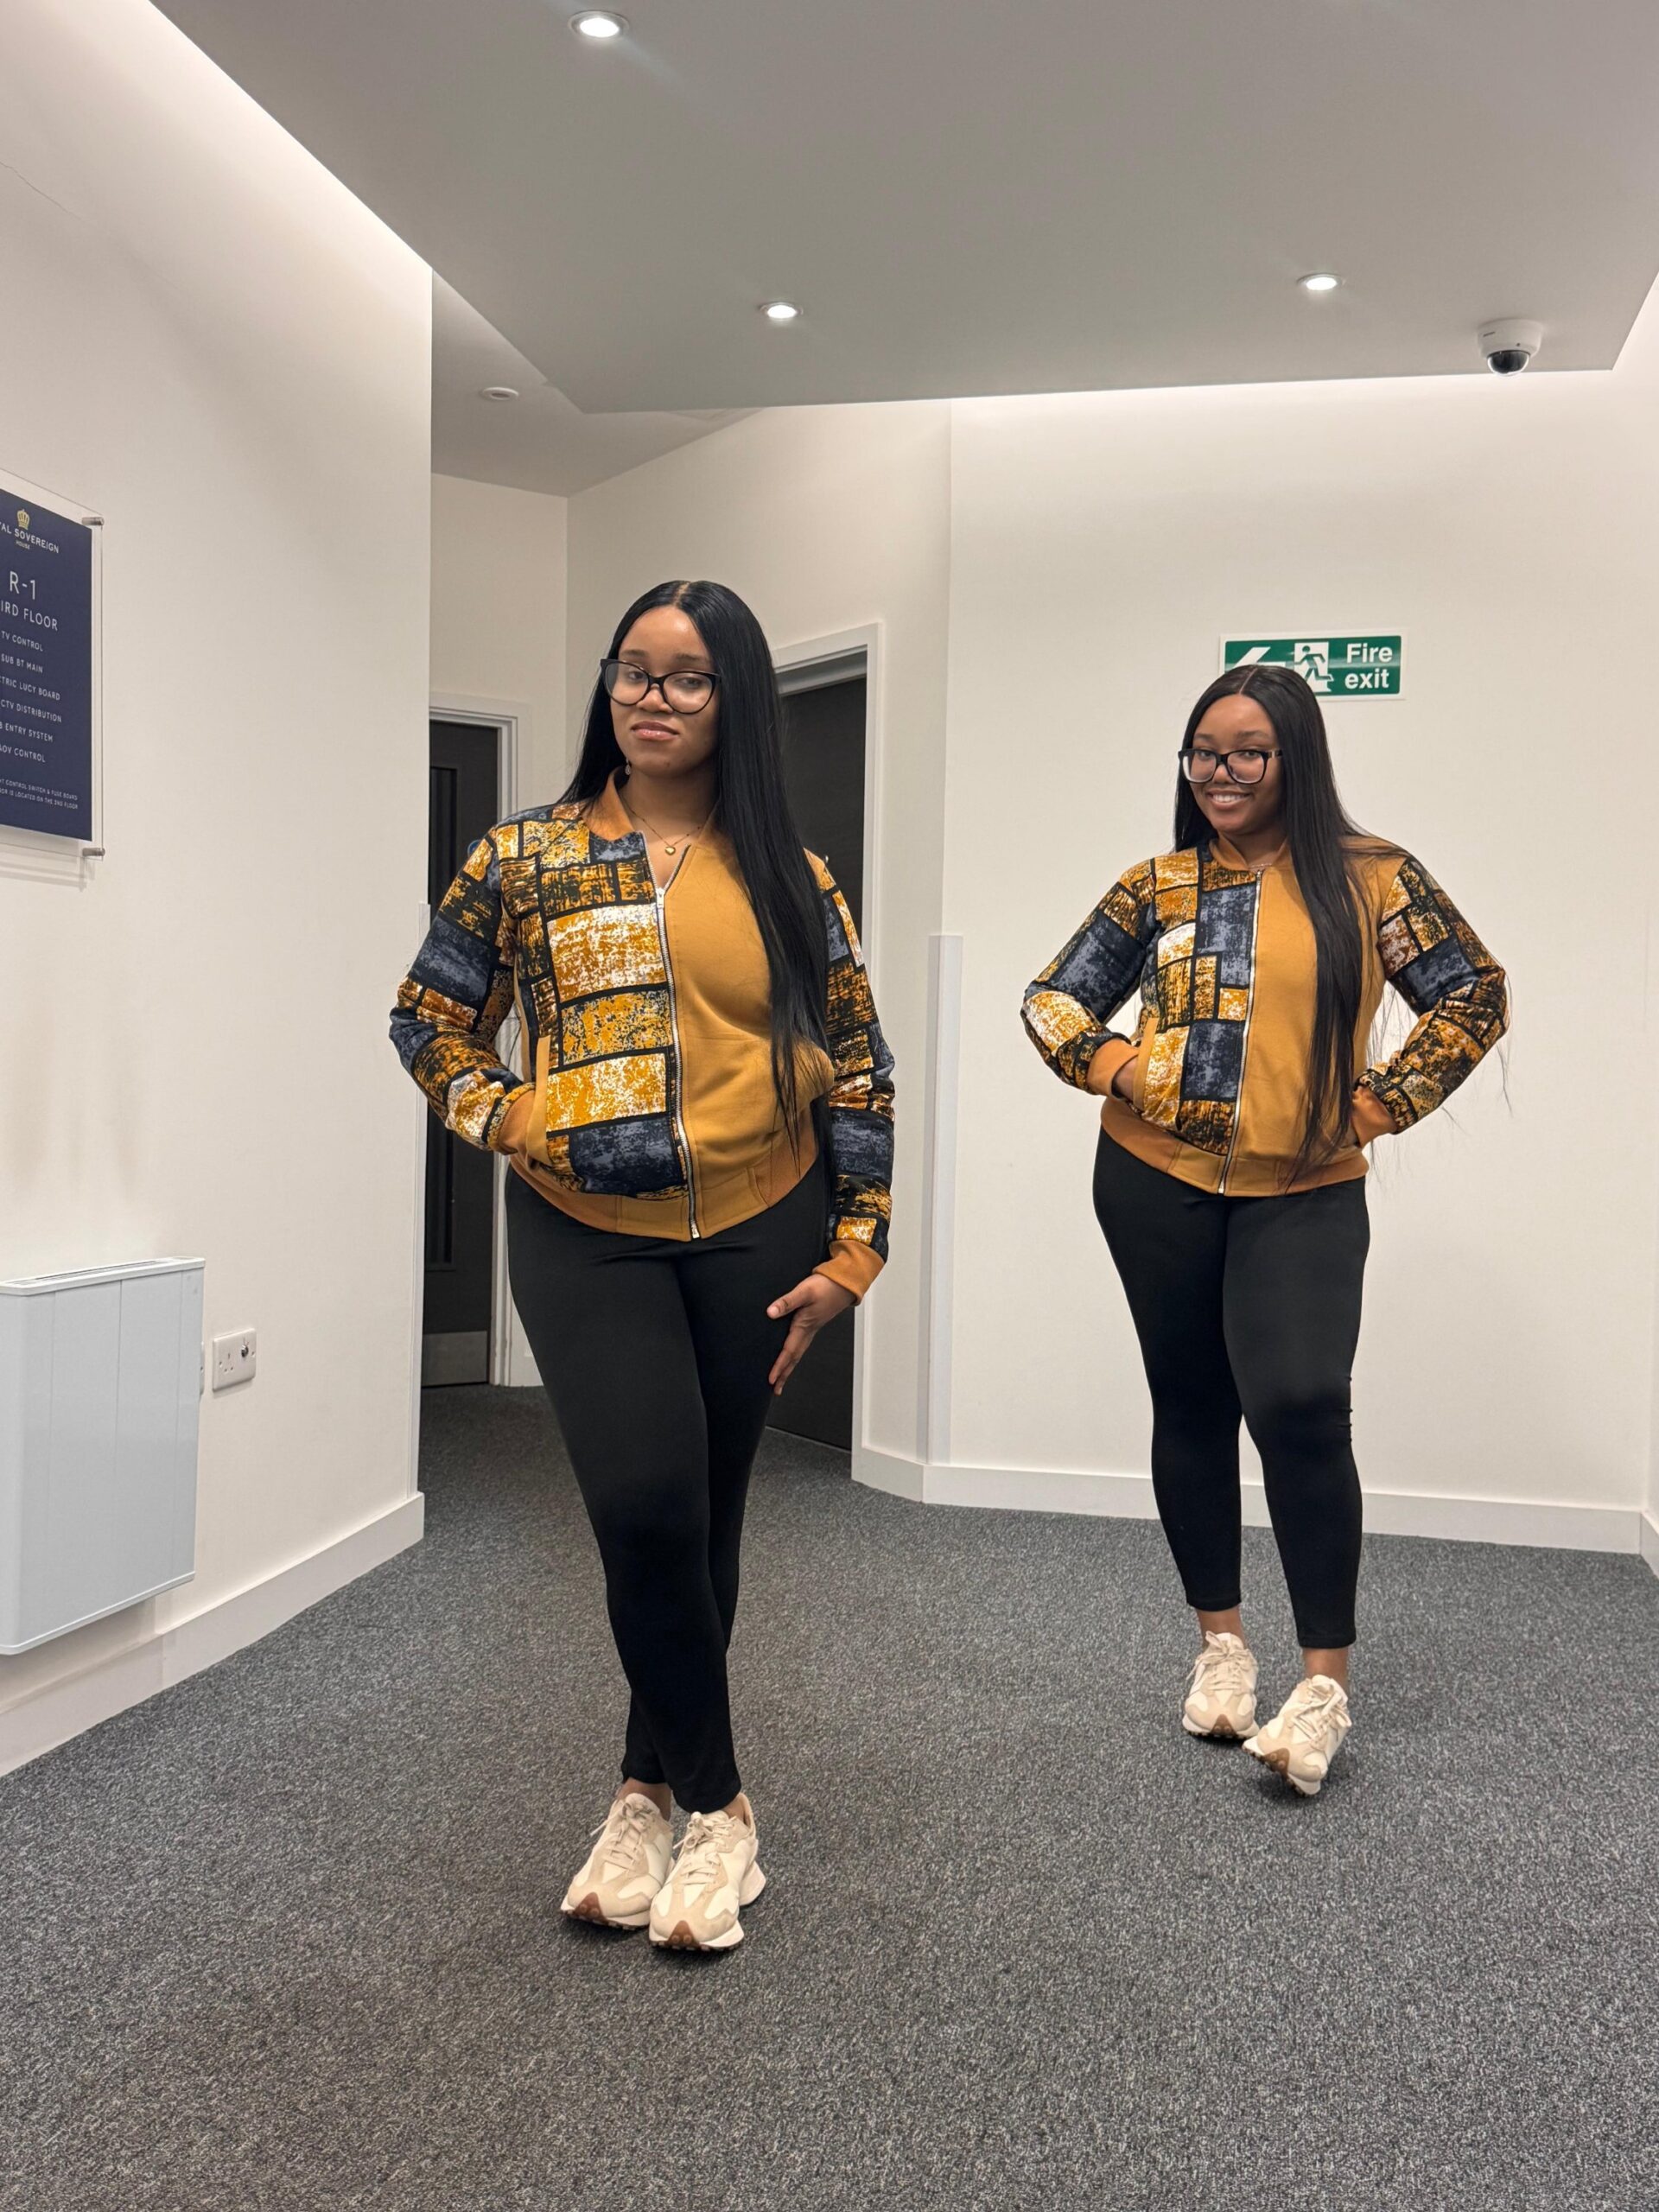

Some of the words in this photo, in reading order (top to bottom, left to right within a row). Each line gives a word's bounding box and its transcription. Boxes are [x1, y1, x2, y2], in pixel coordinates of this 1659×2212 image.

[0, 522, 12, 534] AL
[15, 528, 59, 553] SOVEREIGN
[10, 570, 35, 600] R-1
[24, 608, 58, 631] FLOOR
[12, 635, 43, 652] CONTROL
[1346, 643, 1393, 664] Fire
[1, 653, 14, 664] SUB
[16, 658, 24, 668] BT
[27, 662, 43, 673] MAIN
[0, 676, 17, 688] TRIC
[20, 682, 36, 694] LUCY
[38, 688, 60, 701] BOARD
[1344, 668, 1389, 689] exit
[16, 703, 62, 723] DISTRIBUTION
[5, 722, 26, 735] ENTRY
[29, 729, 53, 742] SYSTEM
[14, 747, 46, 763] CONTROL
[5, 779, 27, 789] CONTROL
[15, 791, 35, 801] LOCATED
